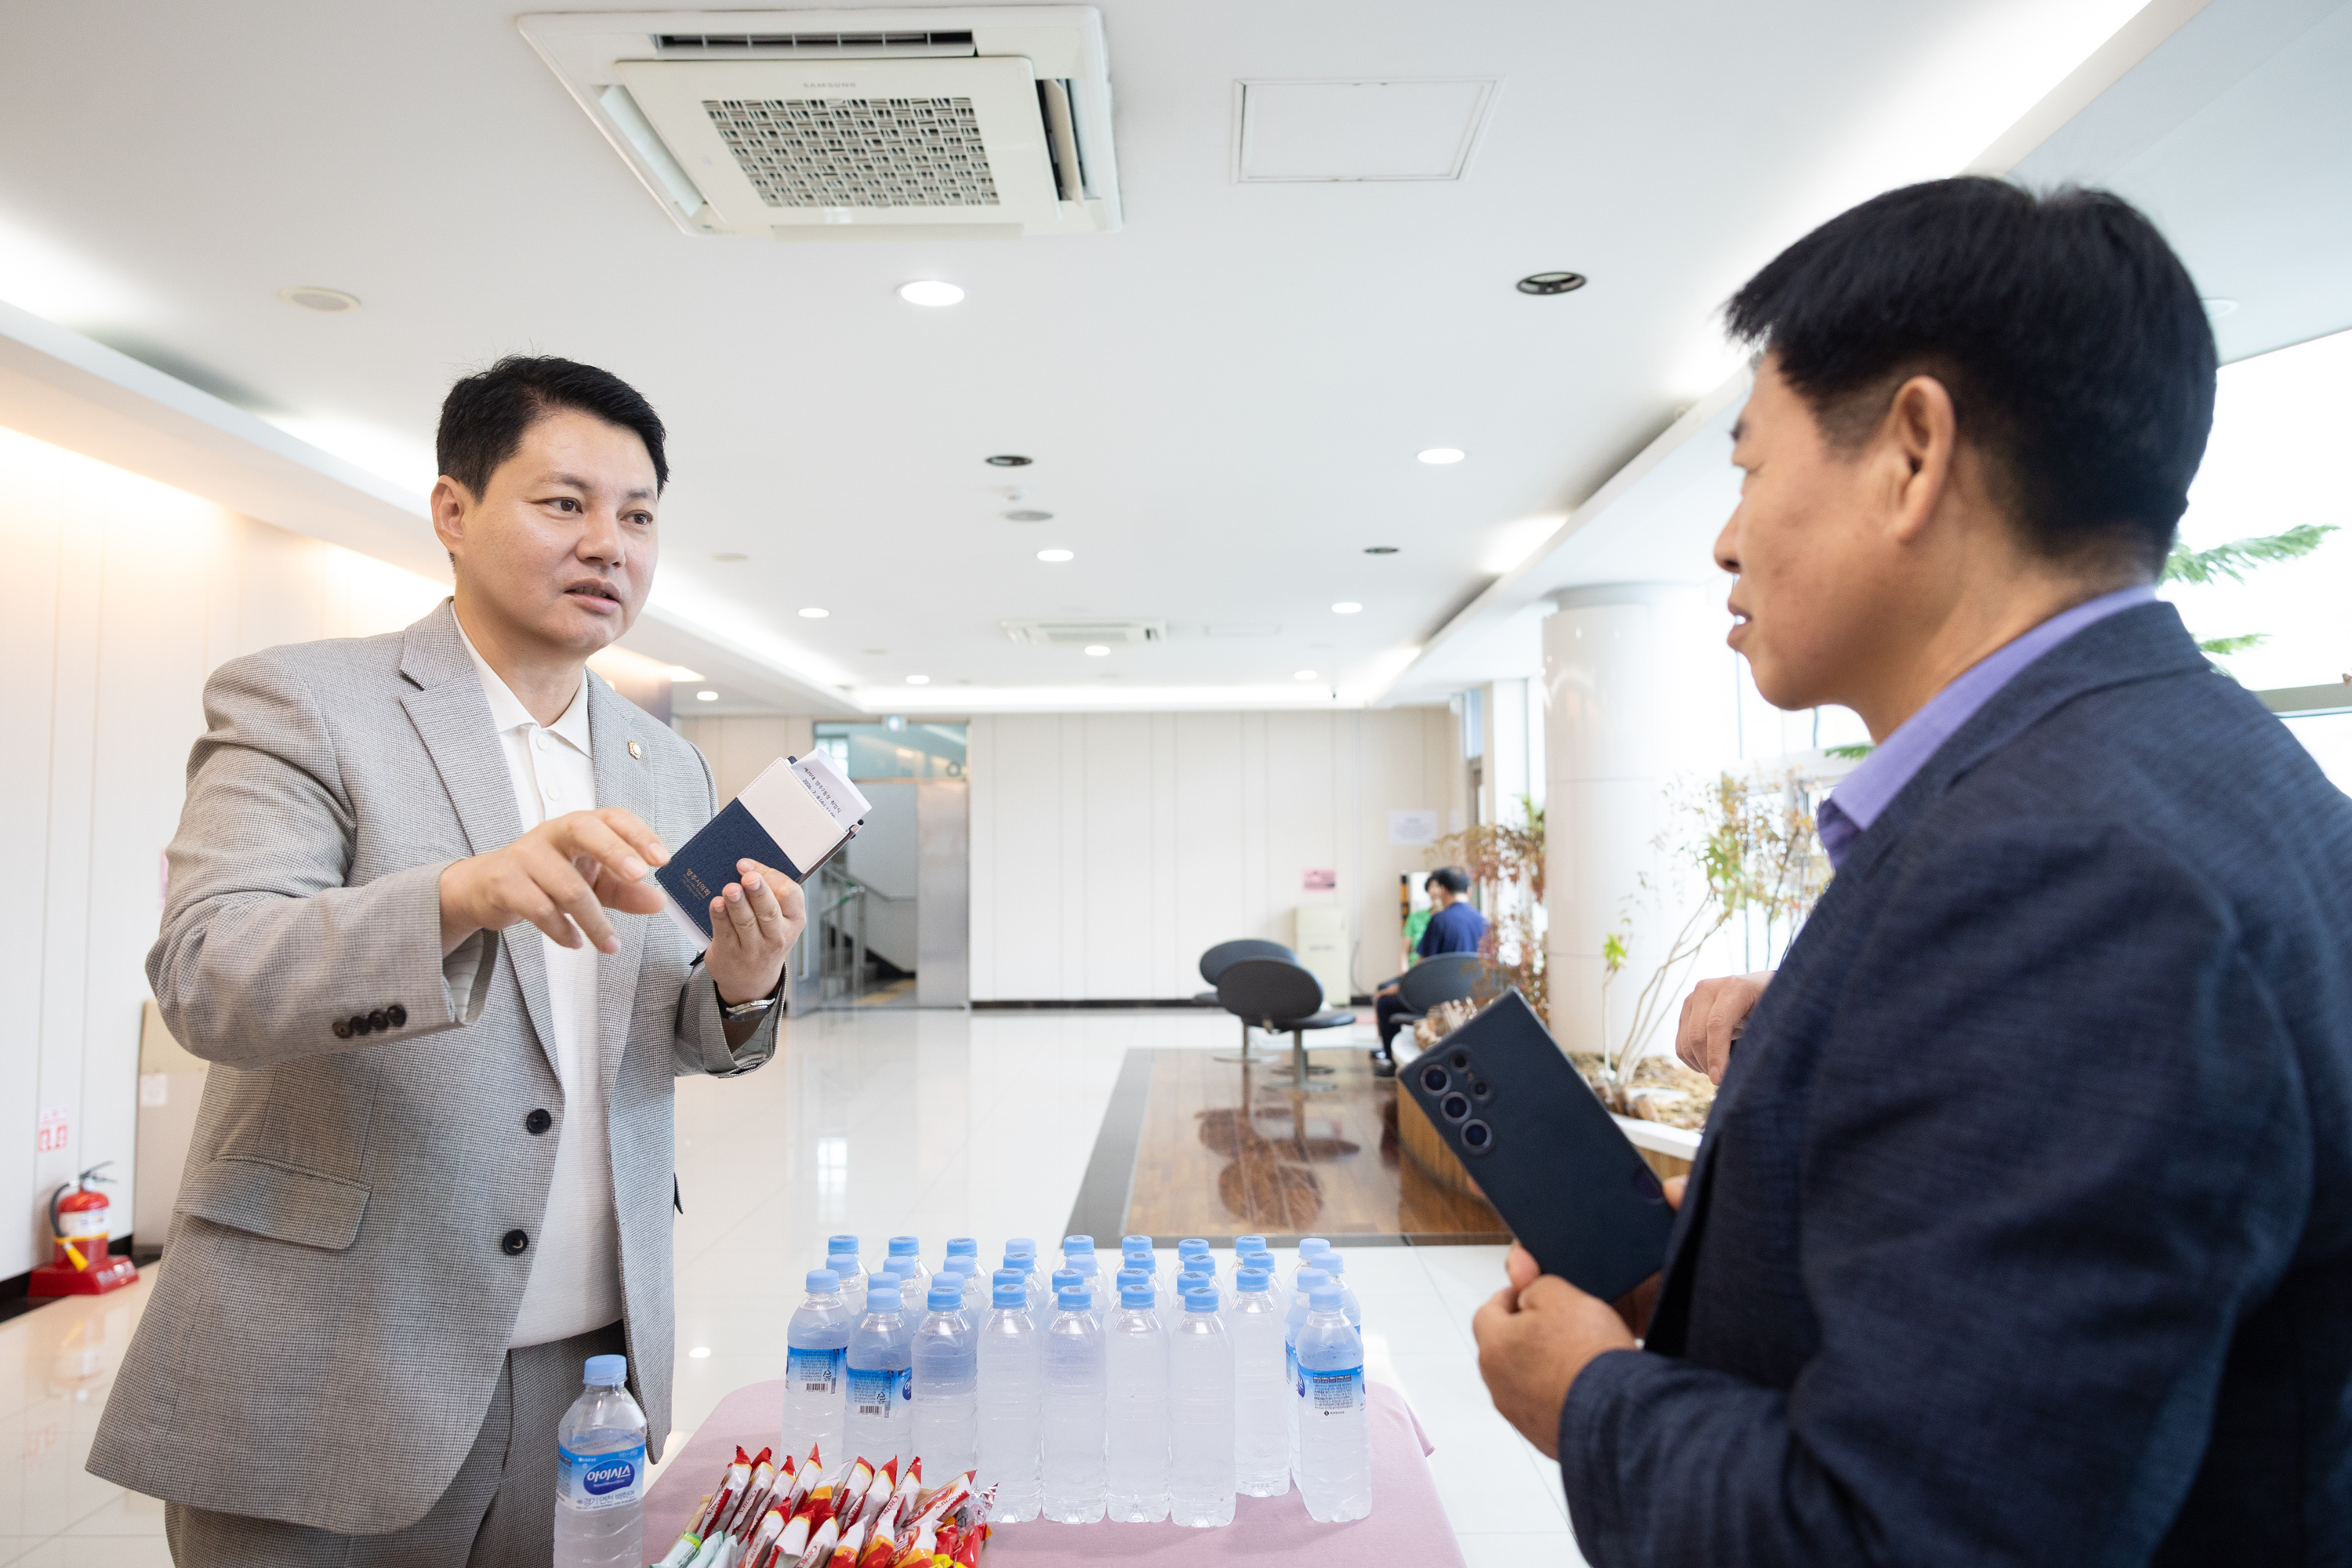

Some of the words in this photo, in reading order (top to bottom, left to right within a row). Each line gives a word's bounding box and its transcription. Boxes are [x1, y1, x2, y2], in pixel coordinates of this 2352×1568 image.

[686, 868, 711, 897] 양주시의회
[586, 1465, 631, 1483] 아이시스
[739, 1490, 757, 1515] CROWN
